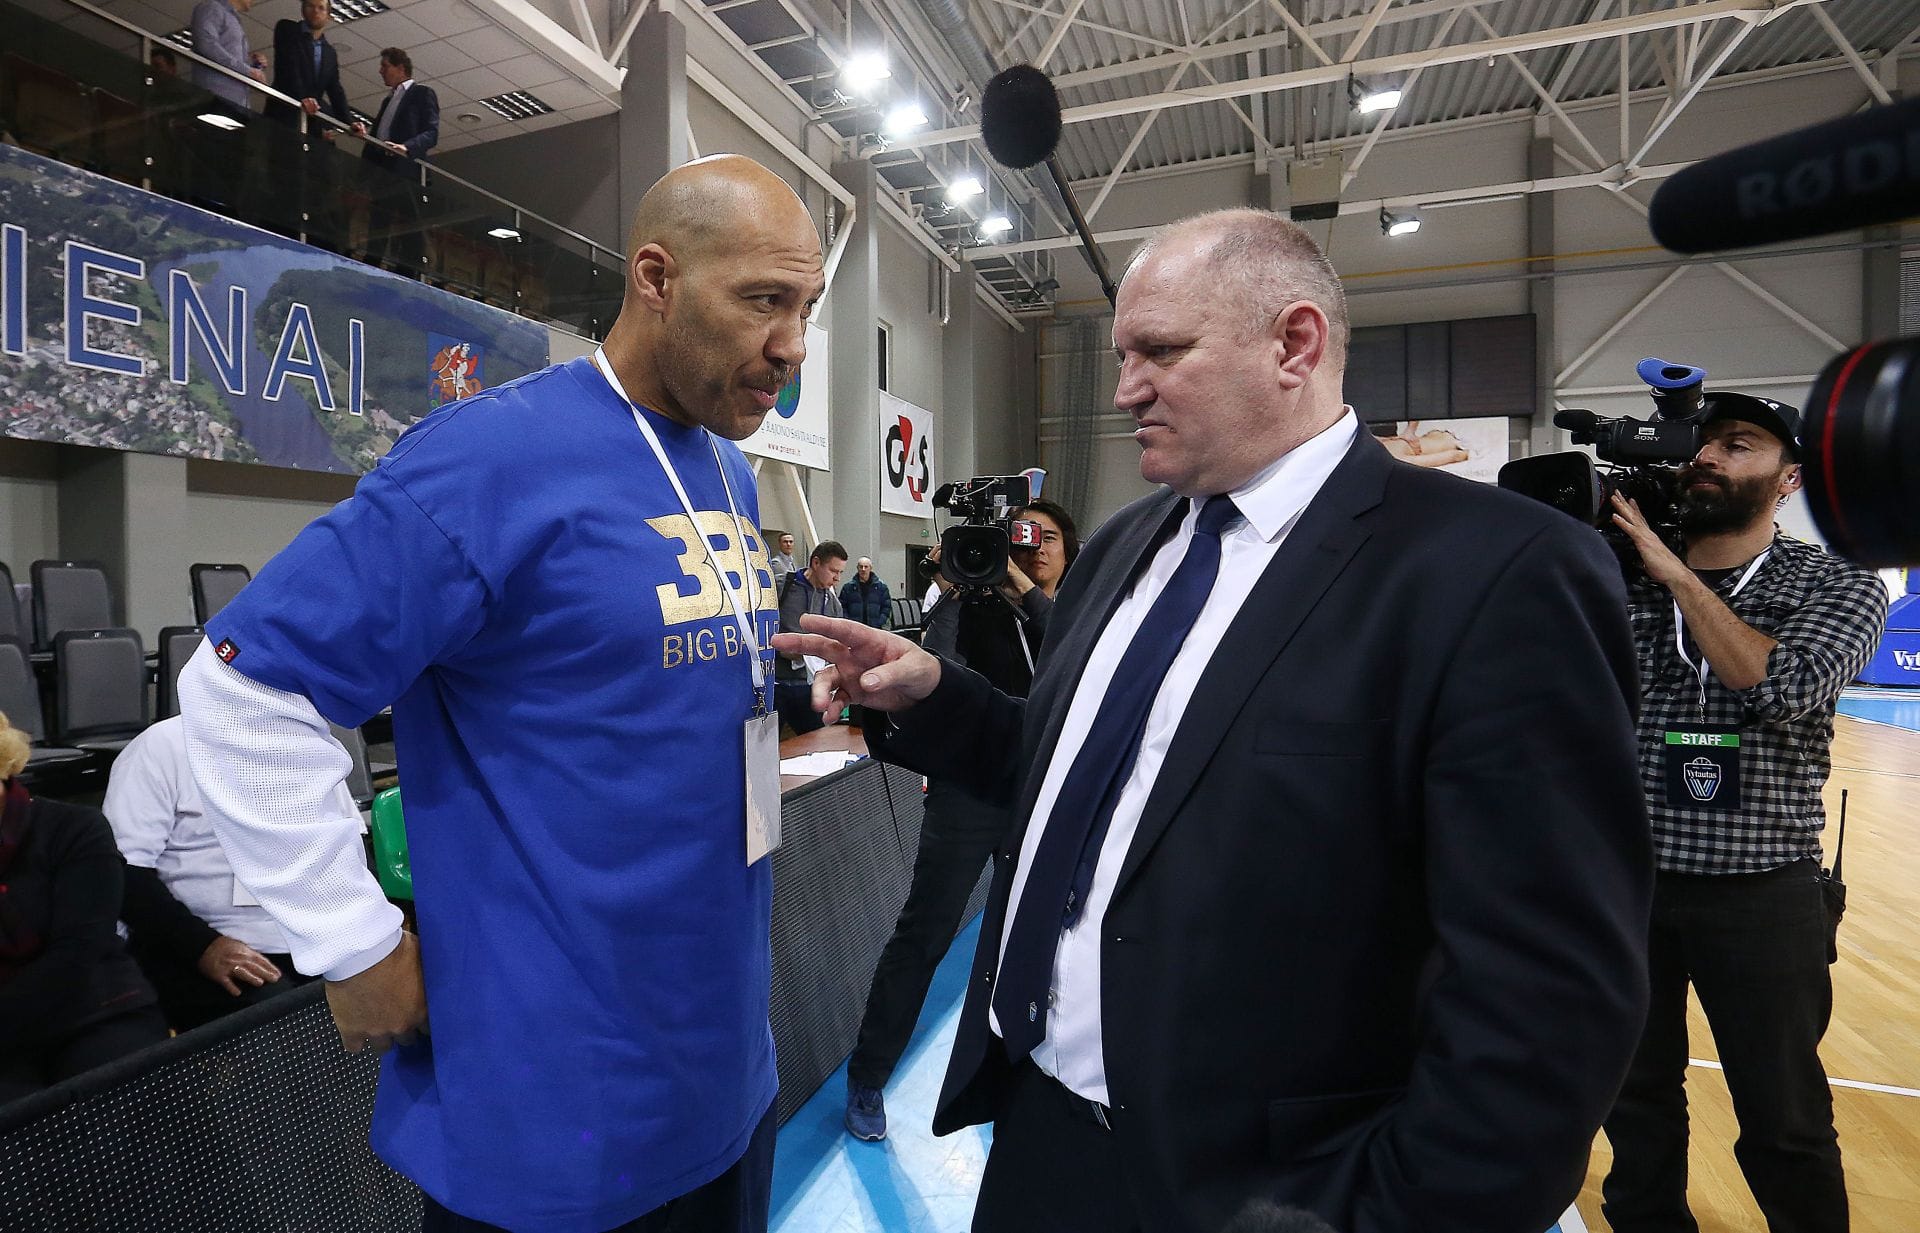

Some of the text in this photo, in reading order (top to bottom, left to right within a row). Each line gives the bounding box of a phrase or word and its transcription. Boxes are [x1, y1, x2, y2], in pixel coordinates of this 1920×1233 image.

[1633, 434, 1661, 442] SONY
[885, 414, 929, 503] G4S
[662, 628, 718, 669] BIG
[1681, 733, 1722, 746] STAFF
[1686, 769, 1718, 779] Vytautas
